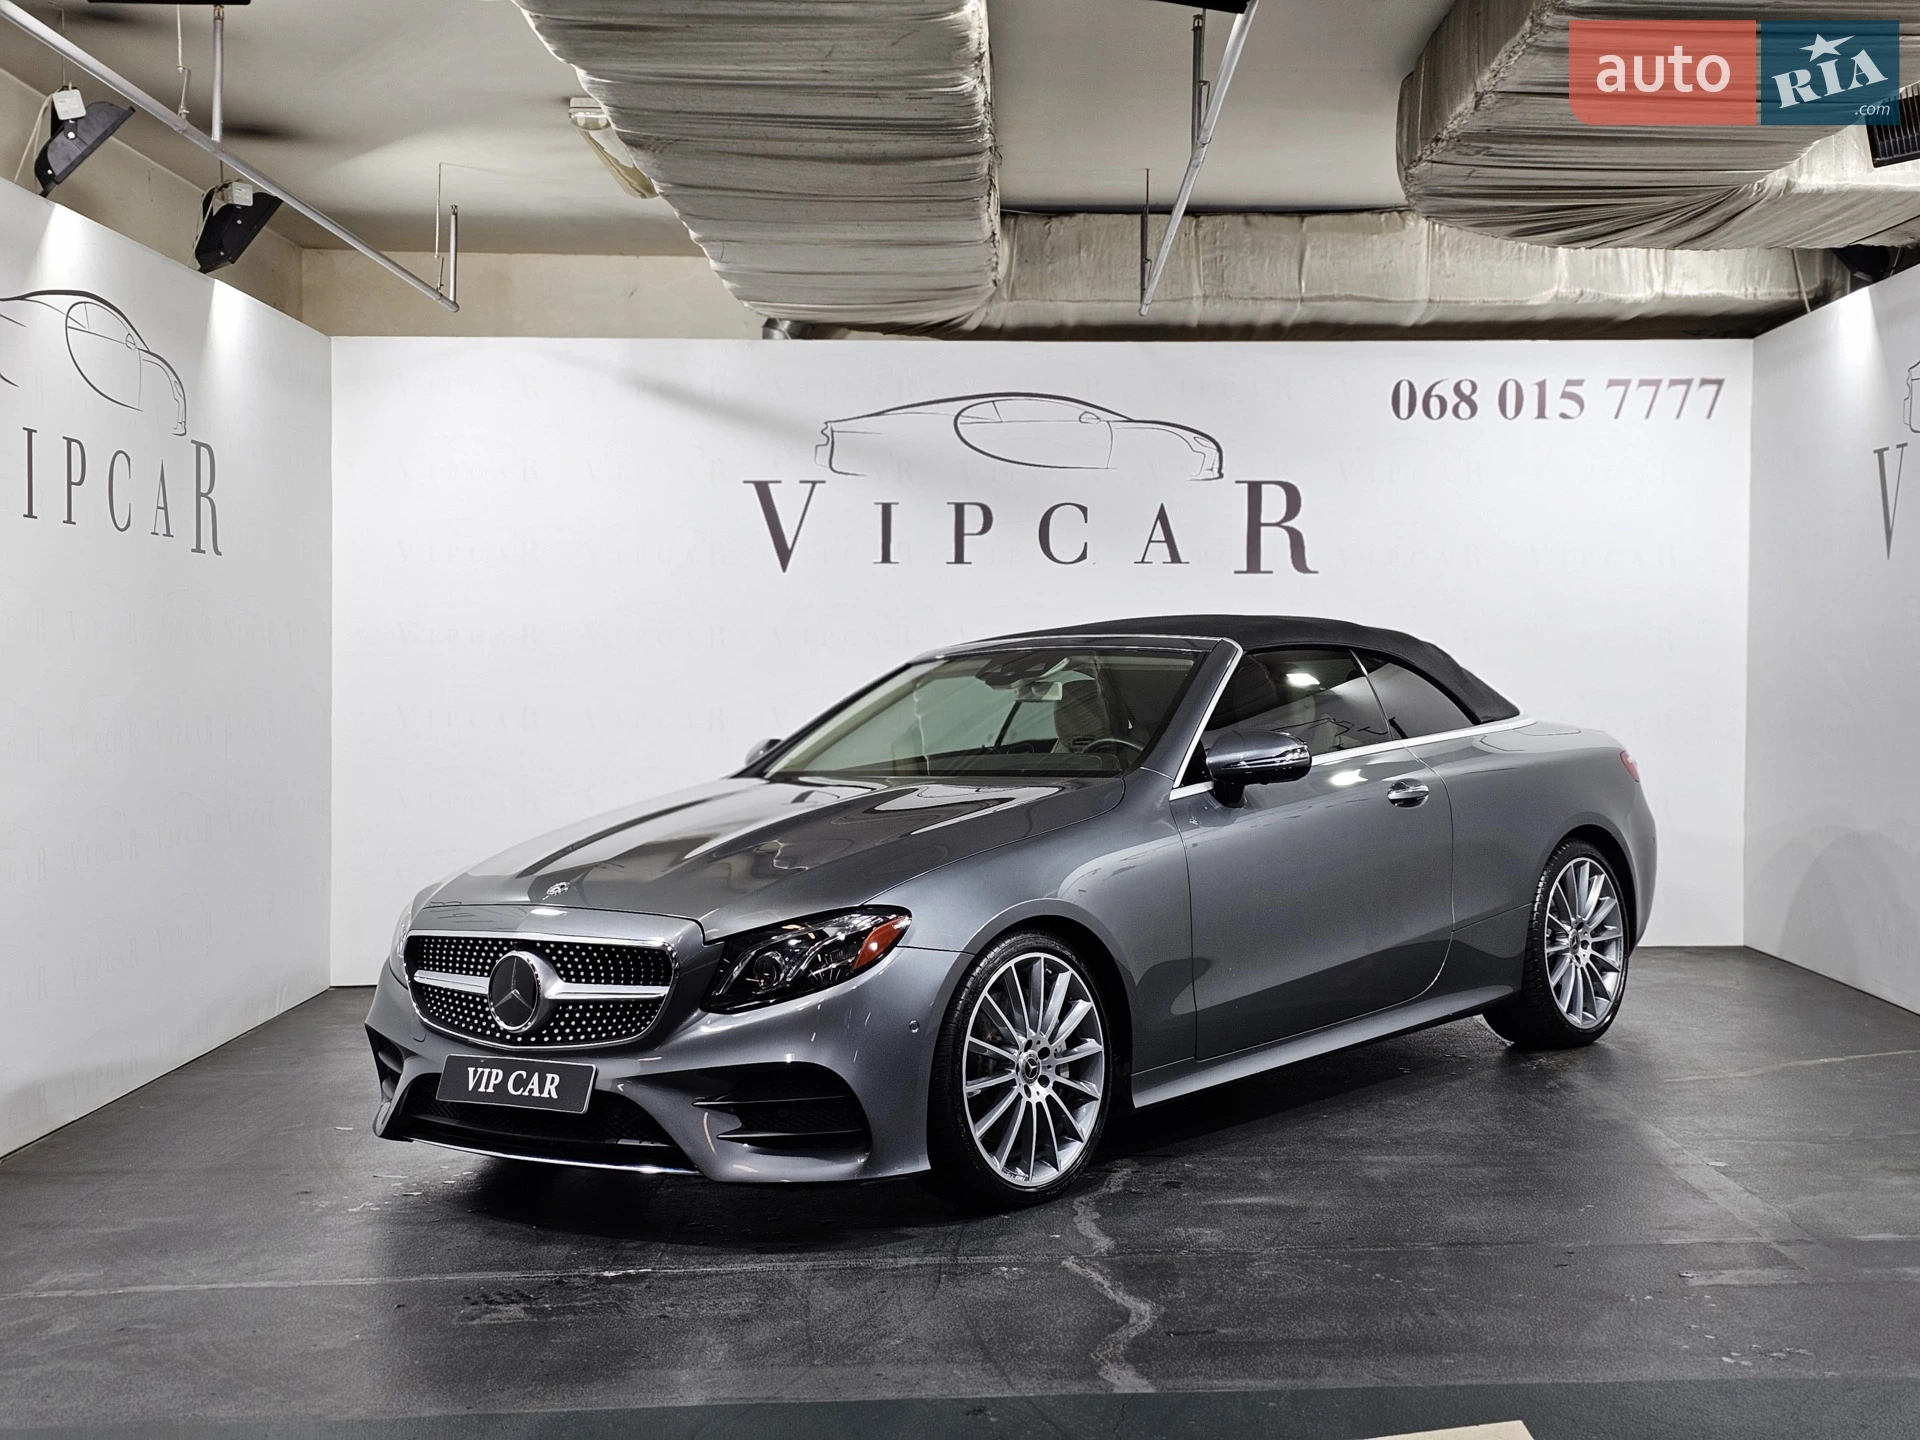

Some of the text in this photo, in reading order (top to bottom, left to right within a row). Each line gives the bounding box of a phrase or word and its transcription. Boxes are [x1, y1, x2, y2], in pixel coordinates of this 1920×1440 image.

[1391, 377, 1726, 421] 068 015 7777
[467, 1067, 560, 1099] VIP CAR
